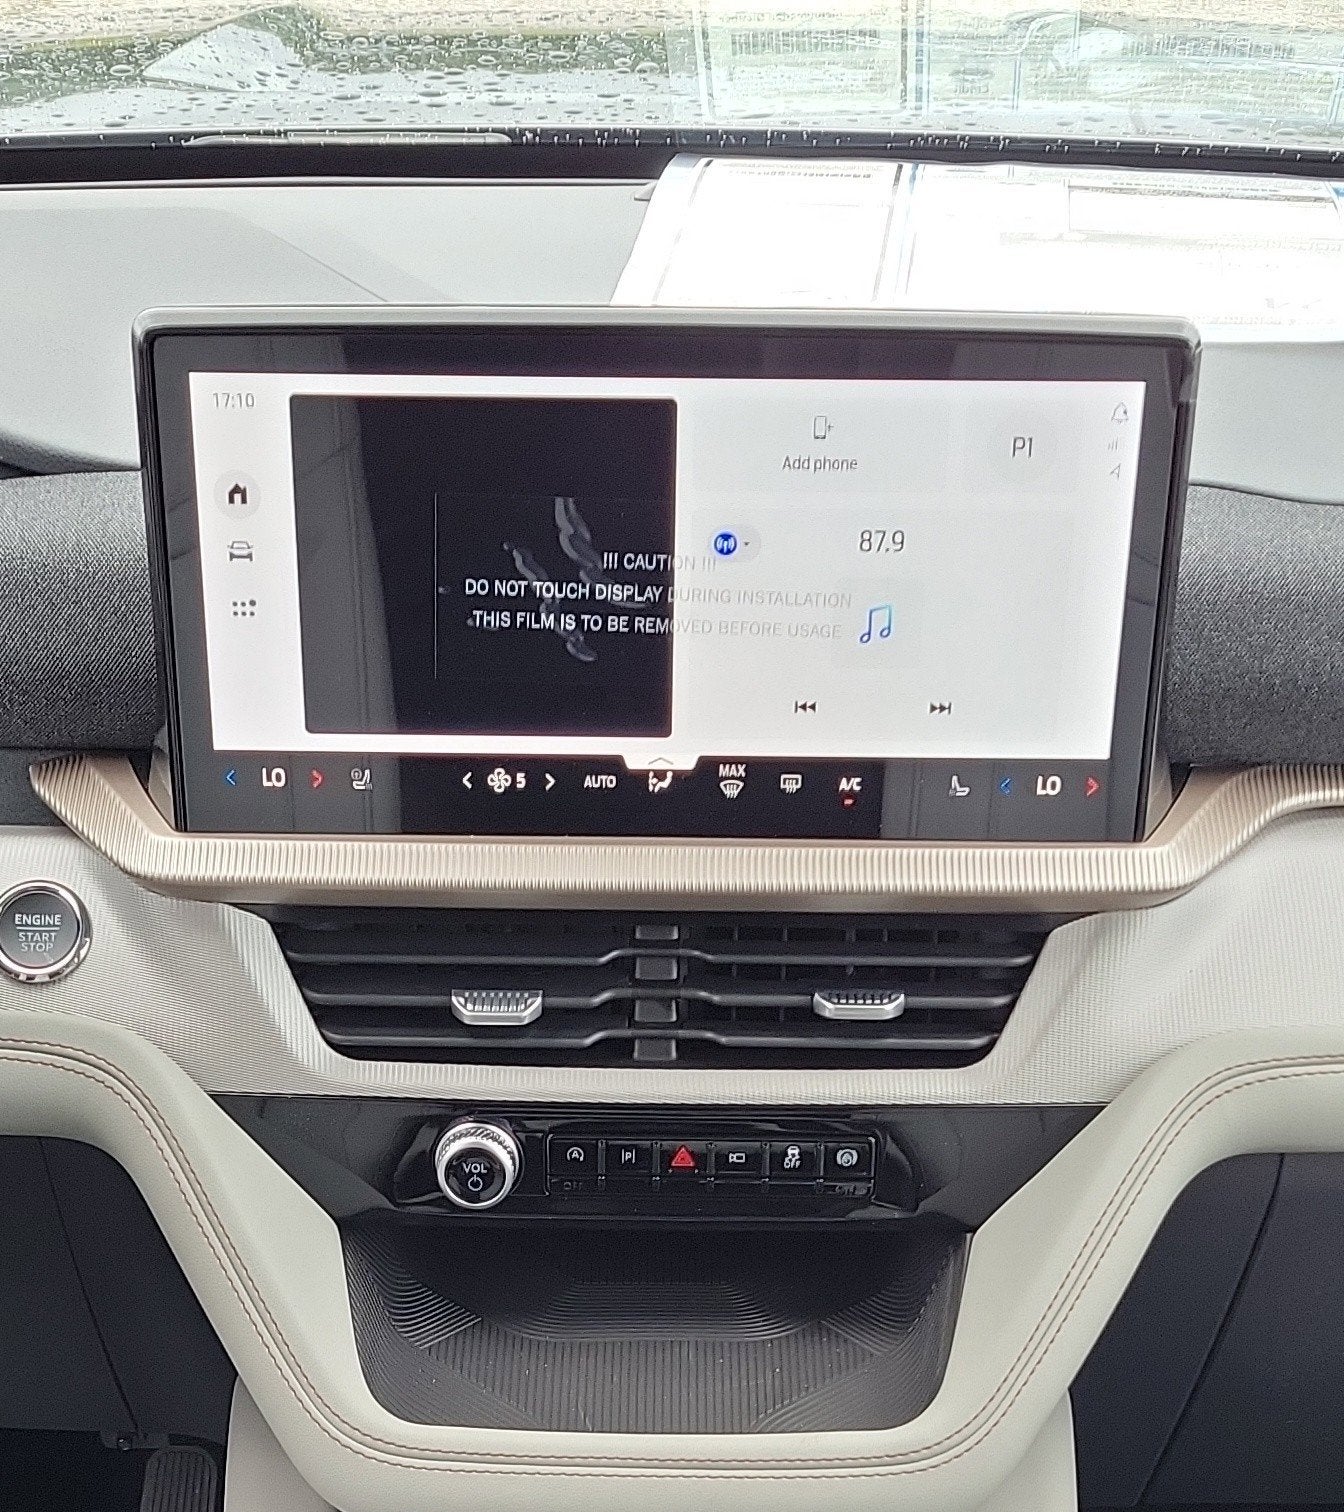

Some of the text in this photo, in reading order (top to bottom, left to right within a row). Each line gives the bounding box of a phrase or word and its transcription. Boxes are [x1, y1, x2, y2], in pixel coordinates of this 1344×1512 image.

[212, 392, 256, 408] 17:10
[1011, 436, 1034, 459] P1
[782, 455, 859, 474] Add phone
[859, 530, 906, 554] 87.9
[623, 553, 696, 572] CAUTION
[465, 578, 852, 608] DO NOT TOUCH DISPLAY DURING INSTALLATION
[472, 610, 843, 639] THIS FILM IS TO BE REMOVED BEFORE USAGE
[261, 767, 287, 788] LO
[718, 764, 746, 778] MAX
[516, 773, 526, 788] 5
[584, 774, 617, 789] AUTO
[838, 777, 862, 793] A/C
[1036, 775, 1062, 796] LO
[14, 913, 62, 926] ENGINE
[18, 932, 57, 942] START
[20, 942, 54, 952] STOP
[463, 1162, 488, 1174] VOL
